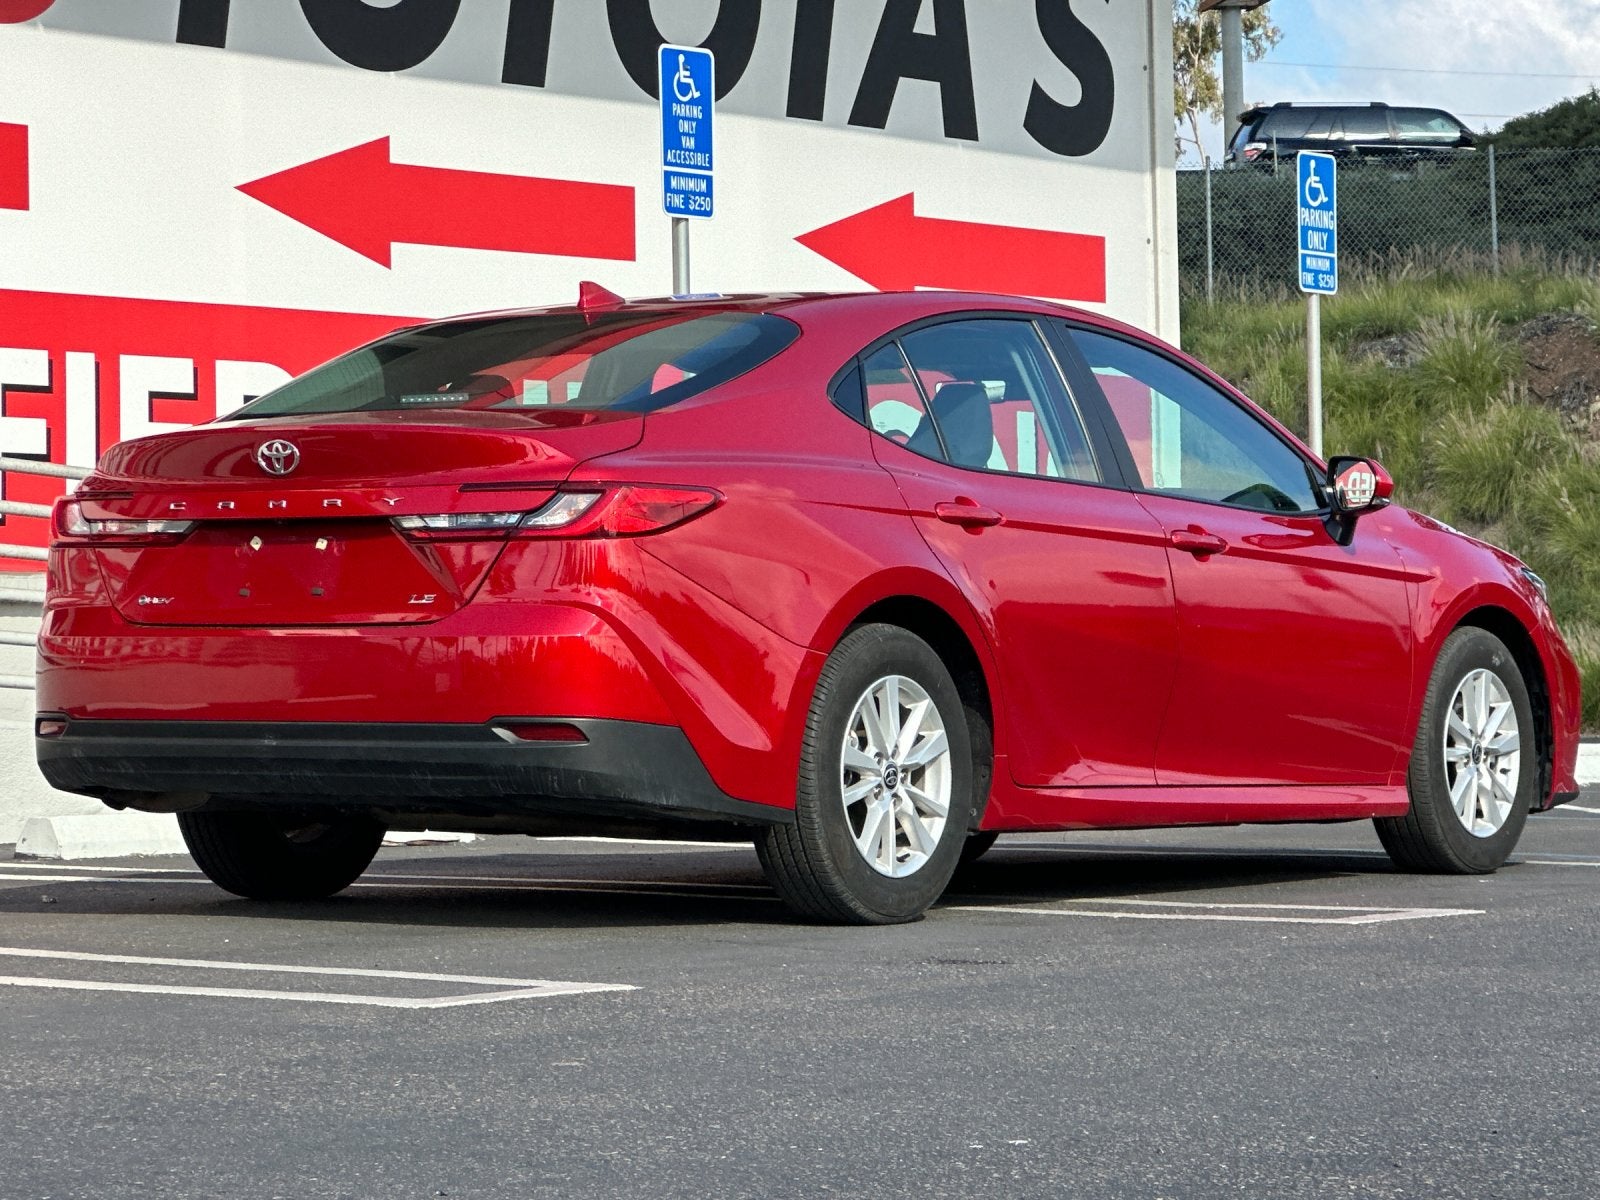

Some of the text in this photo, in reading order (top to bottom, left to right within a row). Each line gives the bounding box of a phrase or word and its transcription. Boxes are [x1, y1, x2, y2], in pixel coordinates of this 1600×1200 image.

[673, 104, 702, 119] PARKING
[679, 120, 696, 134] ONLY
[682, 136, 694, 149] VAN
[667, 150, 709, 166] ACCESSIBLE
[671, 176, 706, 192] MINIMUM
[667, 194, 710, 211] FINE $250
[1302, 208, 1333, 229] PARKING
[1308, 230, 1327, 250] ONLY
[1306, 256, 1330, 271] MINIMUM
[1303, 272, 1334, 288] FINE $250
[169, 496, 405, 510] CAMRY
[408, 594, 437, 604] LE
